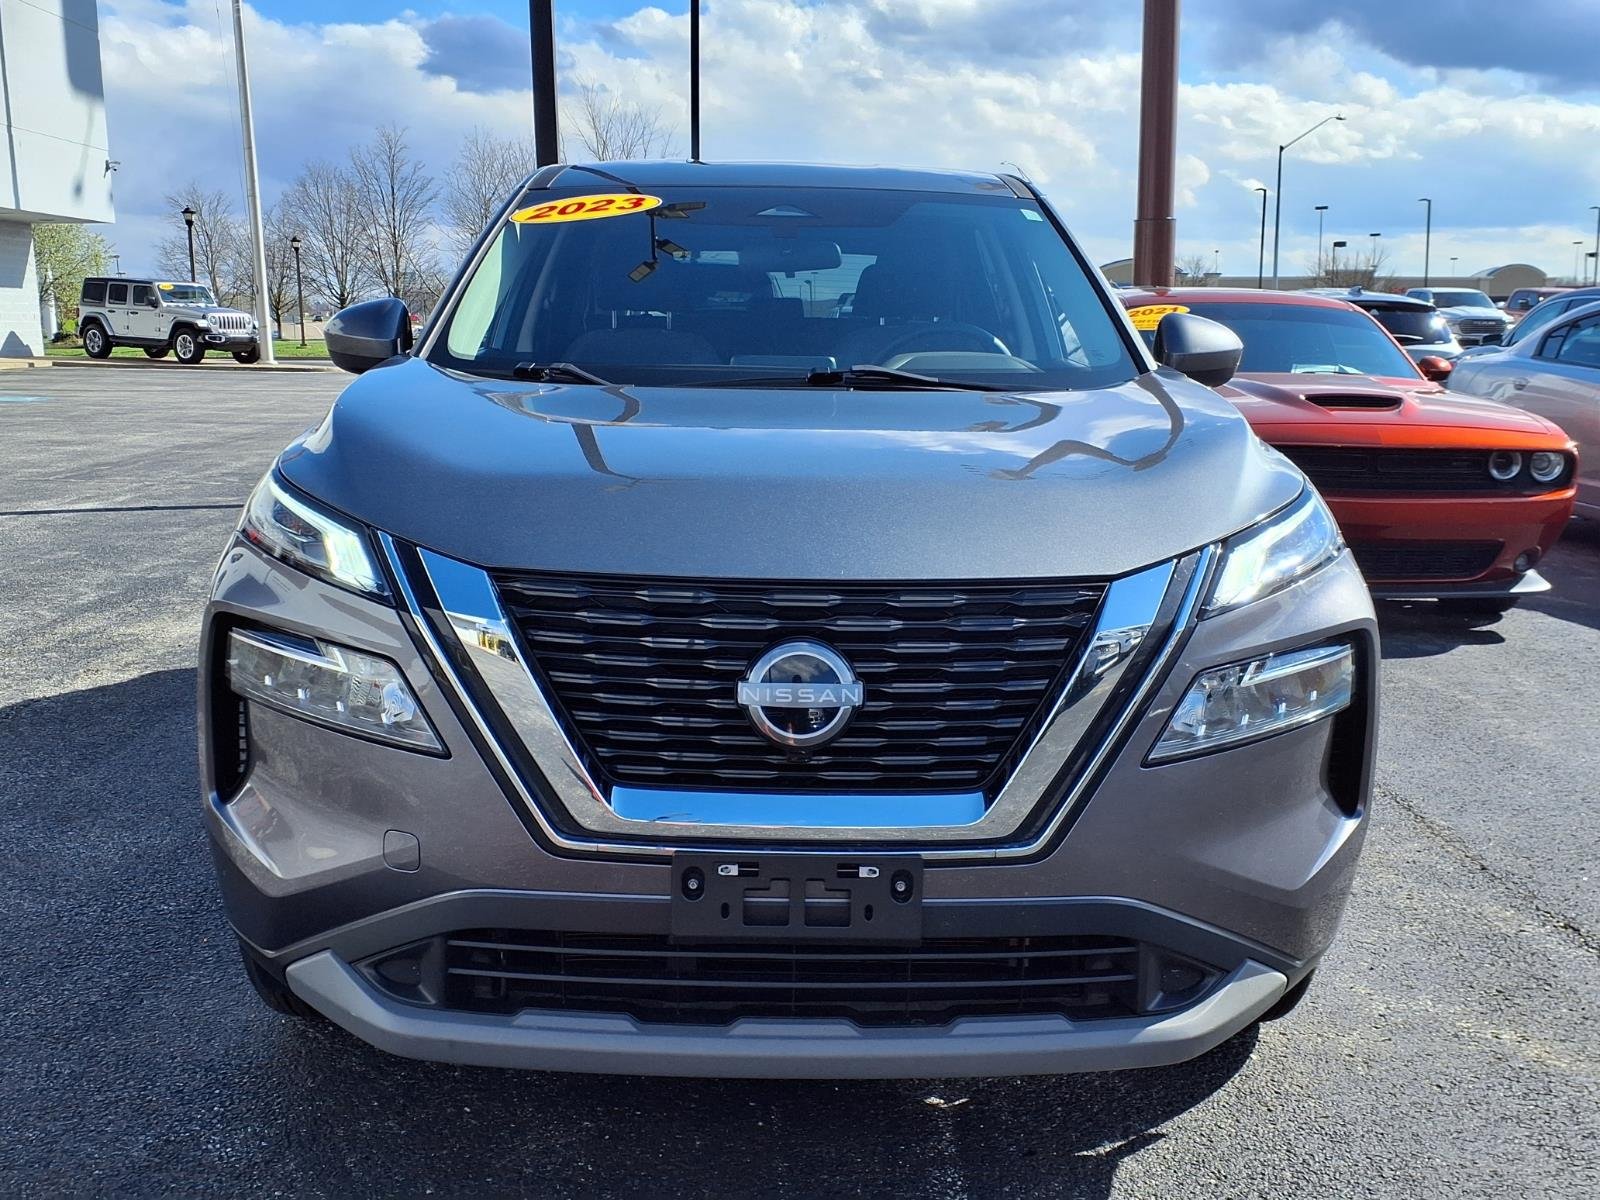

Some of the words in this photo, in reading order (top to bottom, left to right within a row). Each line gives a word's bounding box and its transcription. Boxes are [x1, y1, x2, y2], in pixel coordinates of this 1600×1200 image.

[525, 197, 646, 221] 2023
[1129, 307, 1178, 318] 2021
[742, 687, 859, 703] NISSAN
